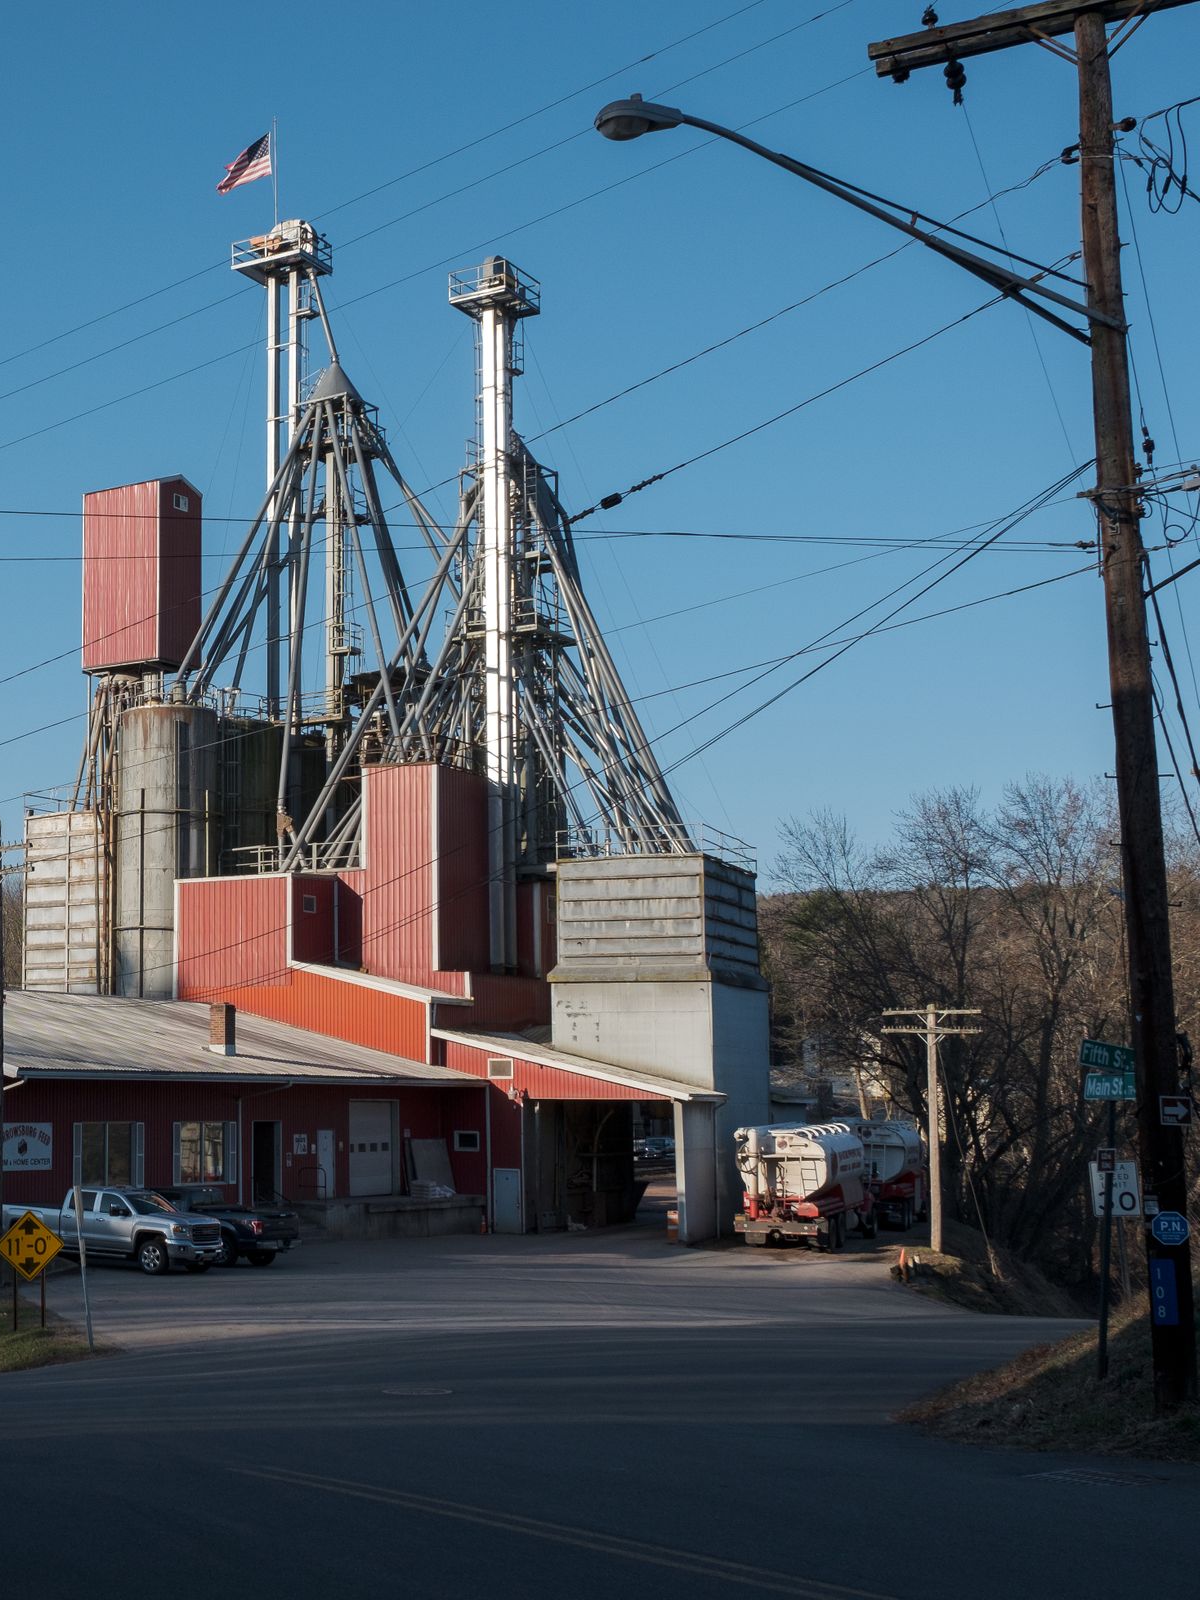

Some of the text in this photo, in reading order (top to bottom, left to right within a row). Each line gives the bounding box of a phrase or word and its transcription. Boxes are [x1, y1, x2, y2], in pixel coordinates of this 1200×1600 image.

[1082, 1042, 1110, 1065] Fifth
[1086, 1078, 1110, 1096] Main
[38, 1130, 51, 1146] FEED
[13, 1158, 29, 1166] HOME
[30, 1158, 51, 1166] CENTER
[1098, 1173, 1129, 1181] SEED
[1160, 1221, 1185, 1232] P.N.
